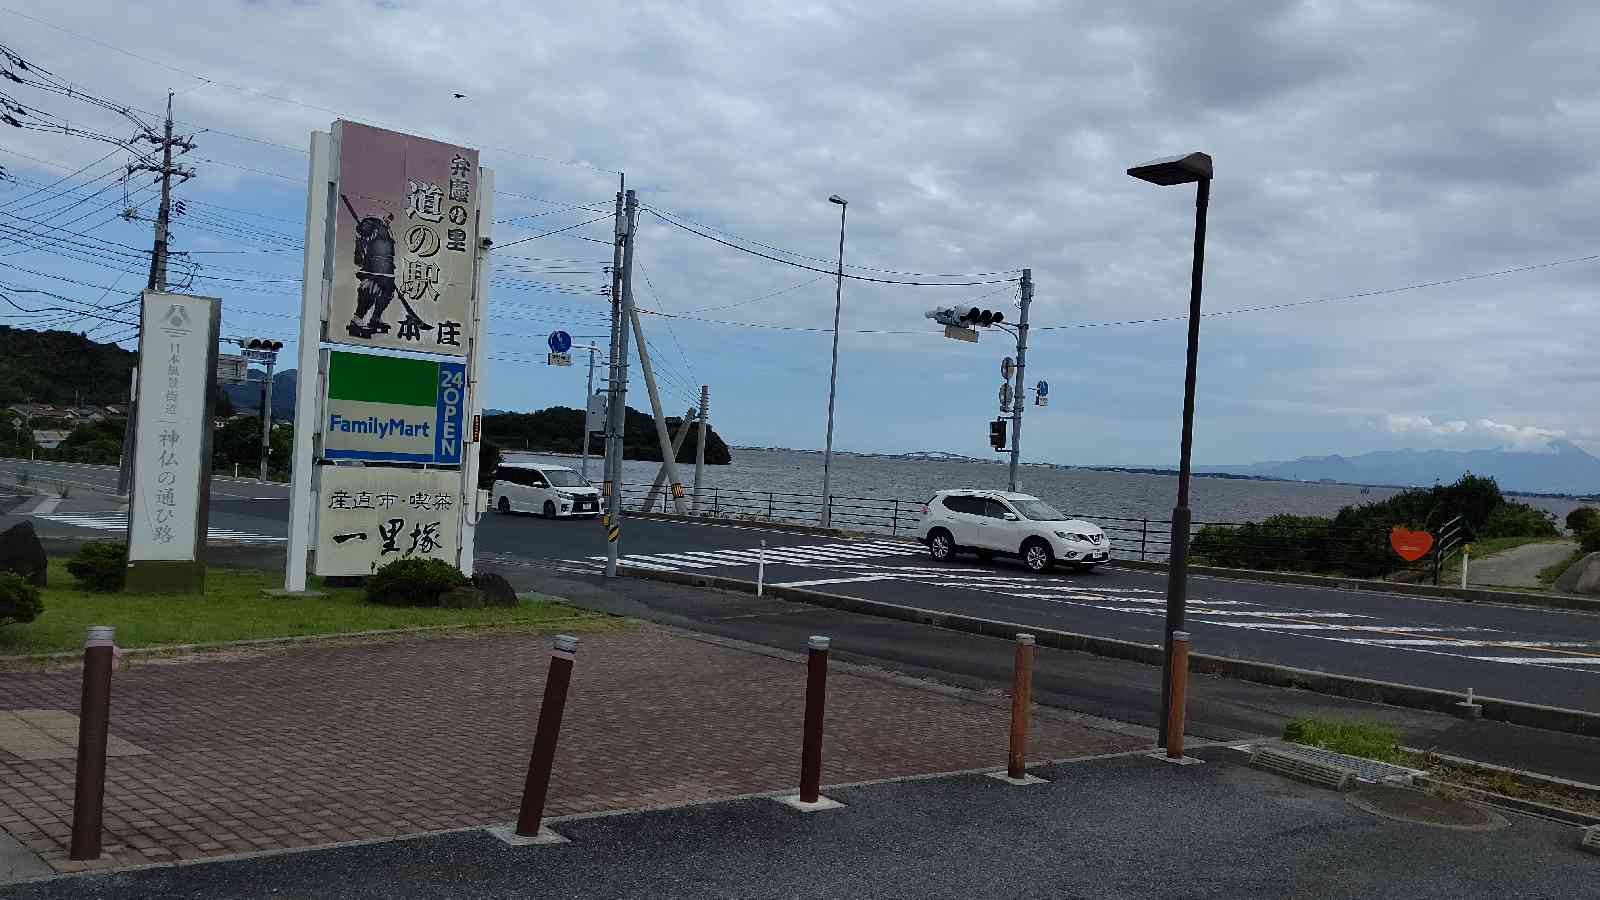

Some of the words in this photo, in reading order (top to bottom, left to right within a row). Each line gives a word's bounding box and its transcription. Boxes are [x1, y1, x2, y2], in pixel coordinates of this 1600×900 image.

[403, 177, 444, 301] 道の駅
[441, 371, 463, 389] 24
[330, 415, 430, 439] FamilyMart
[441, 388, 459, 457] OPEN
[152, 429, 180, 544] 神仏の通び路
[332, 518, 442, 555] 一里塚
